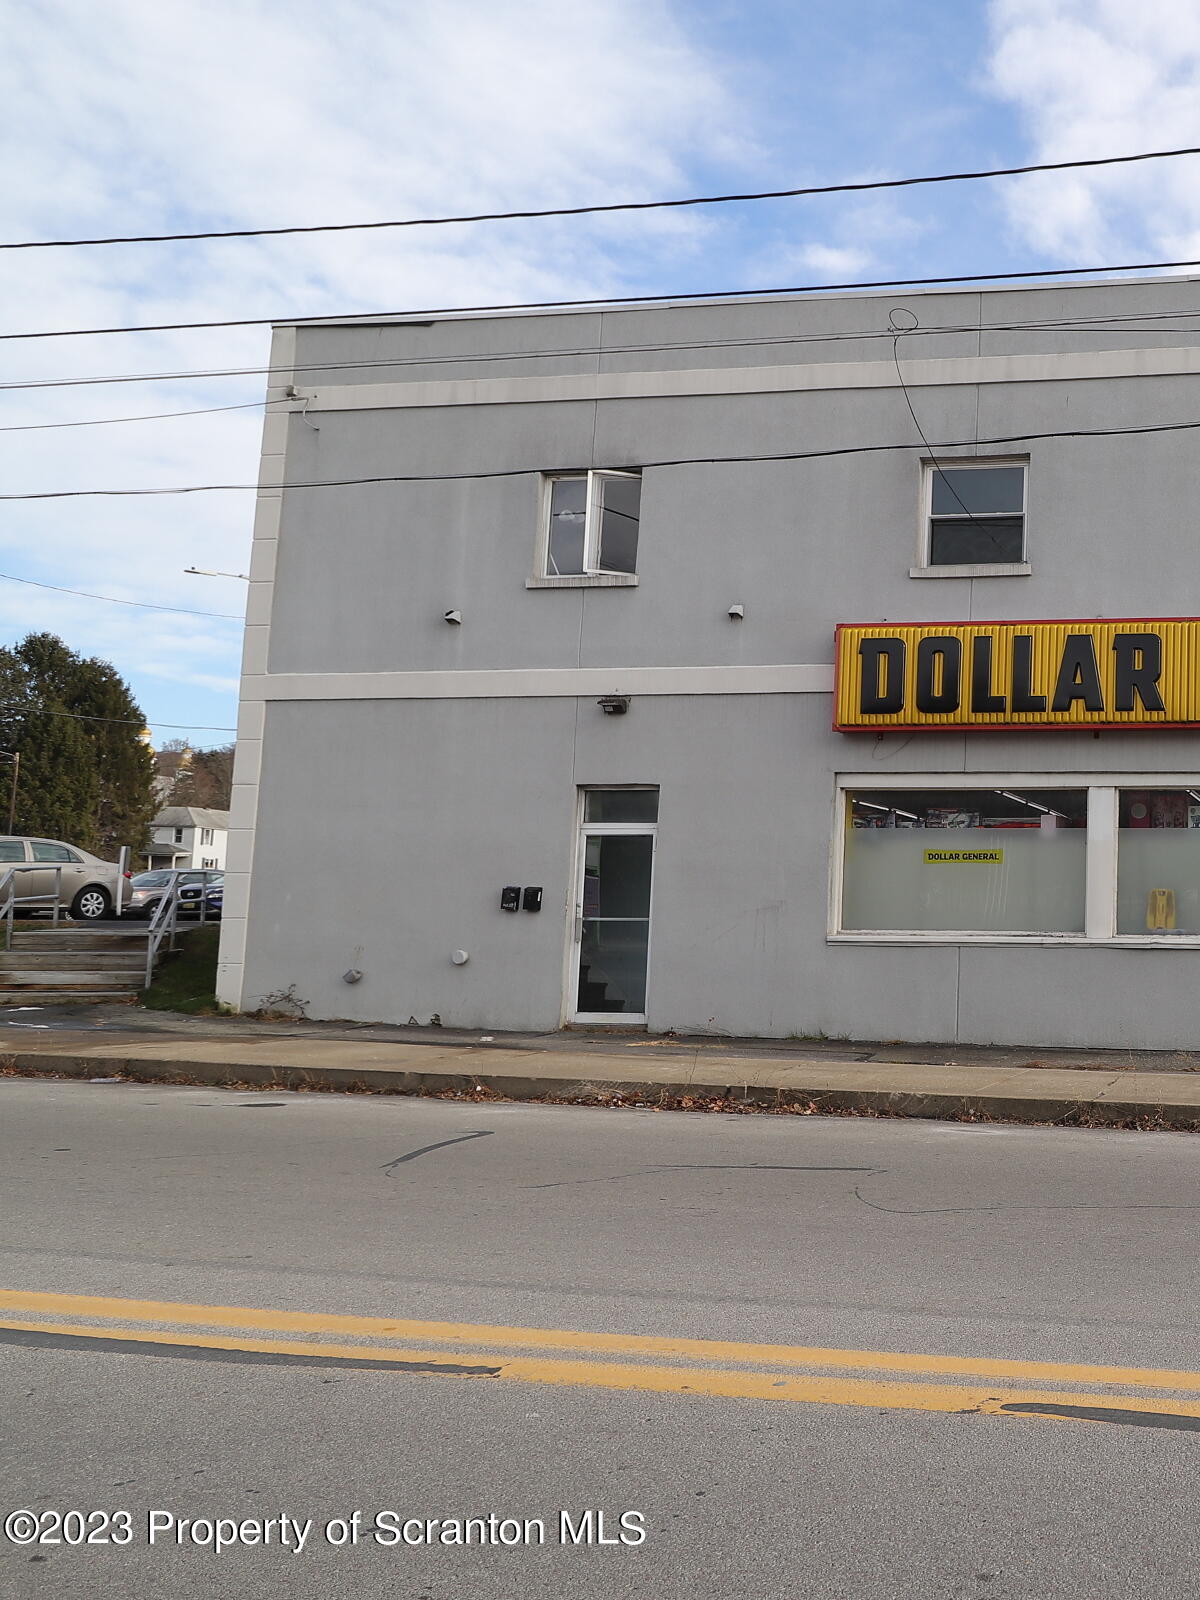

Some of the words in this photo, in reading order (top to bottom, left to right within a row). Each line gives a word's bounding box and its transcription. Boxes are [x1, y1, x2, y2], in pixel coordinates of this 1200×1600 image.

[858, 632, 1167, 715] DOLLAR
[927, 852, 960, 861] DOLLAR
[962, 852, 1000, 861] GENERAL
